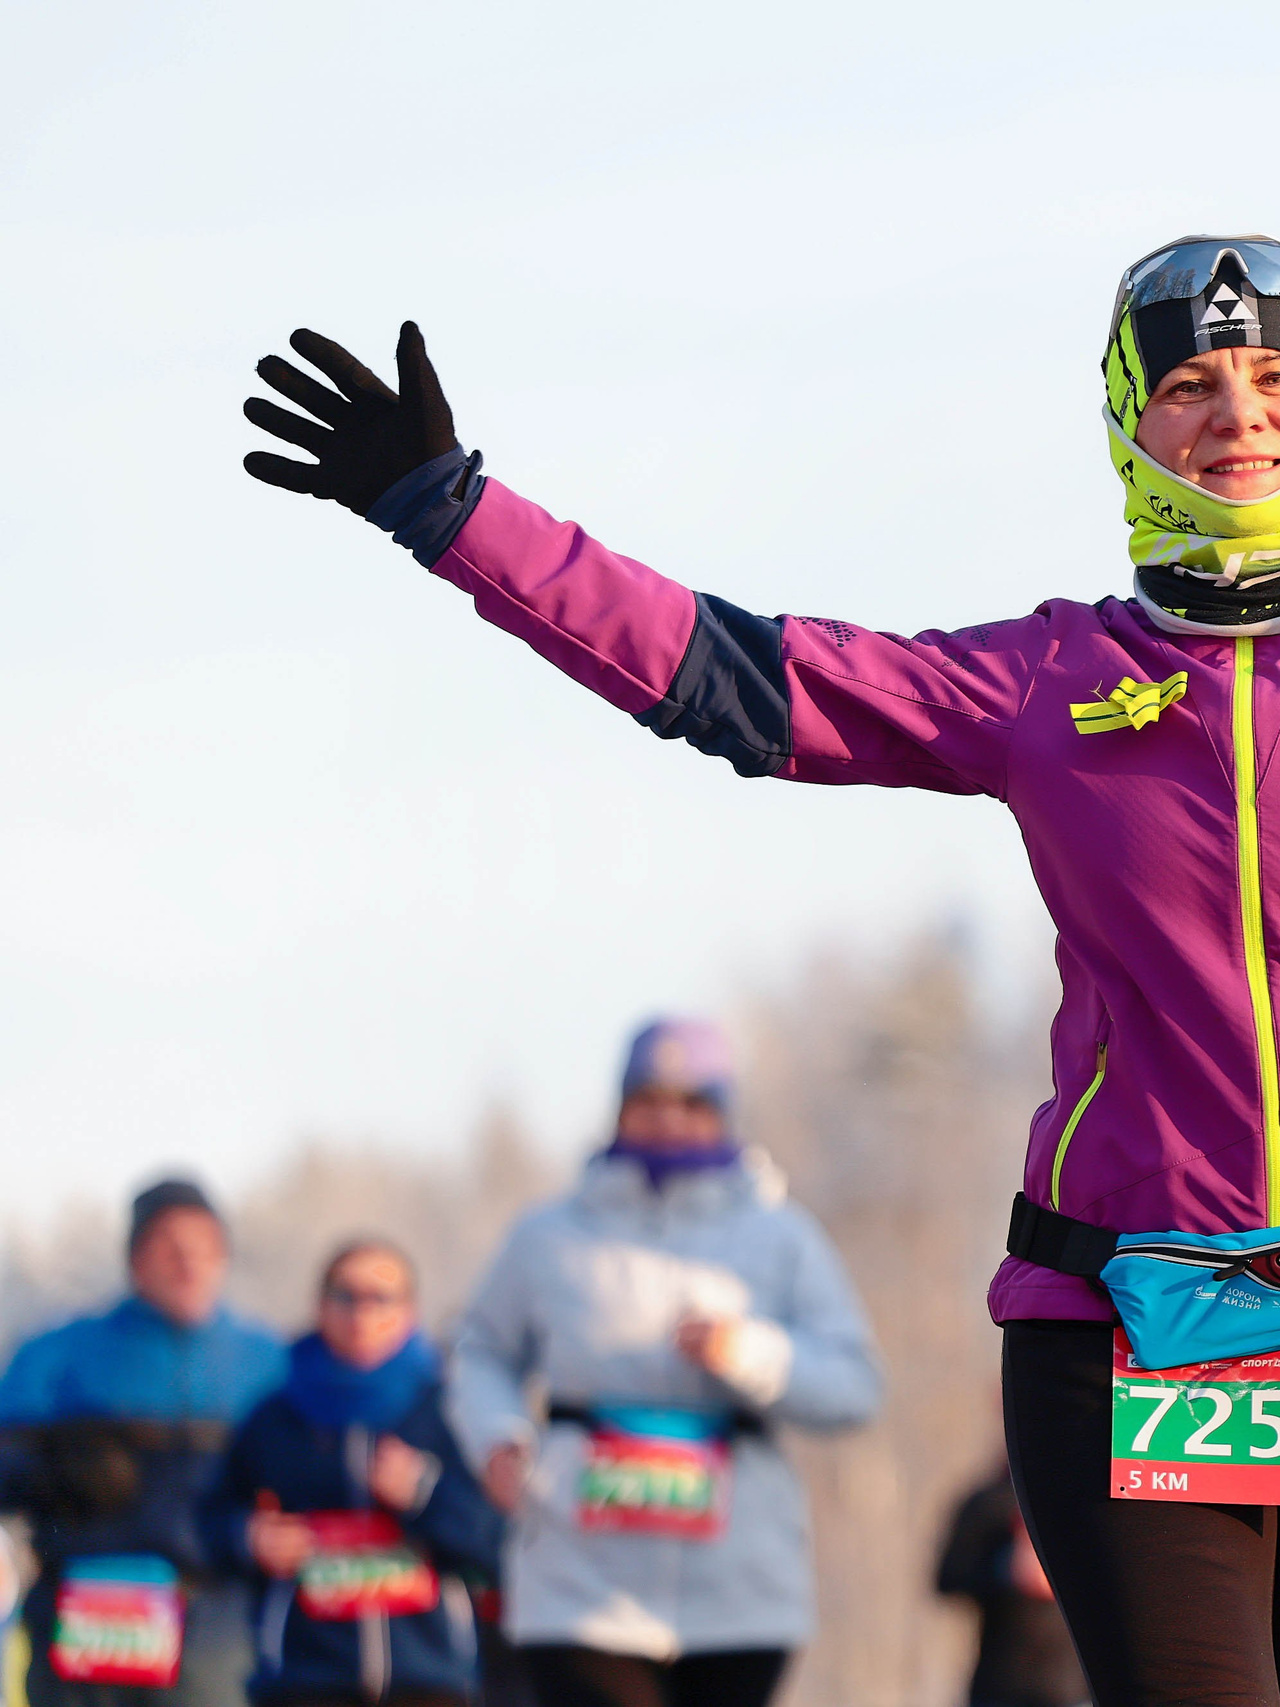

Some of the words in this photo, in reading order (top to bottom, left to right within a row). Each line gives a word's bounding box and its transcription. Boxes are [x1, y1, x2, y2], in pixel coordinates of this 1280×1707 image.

[1194, 323, 1263, 338] FISCHER
[1221, 1295, 1261, 1310] ЖИЗНИ
[1129, 1470, 1142, 1489] 5
